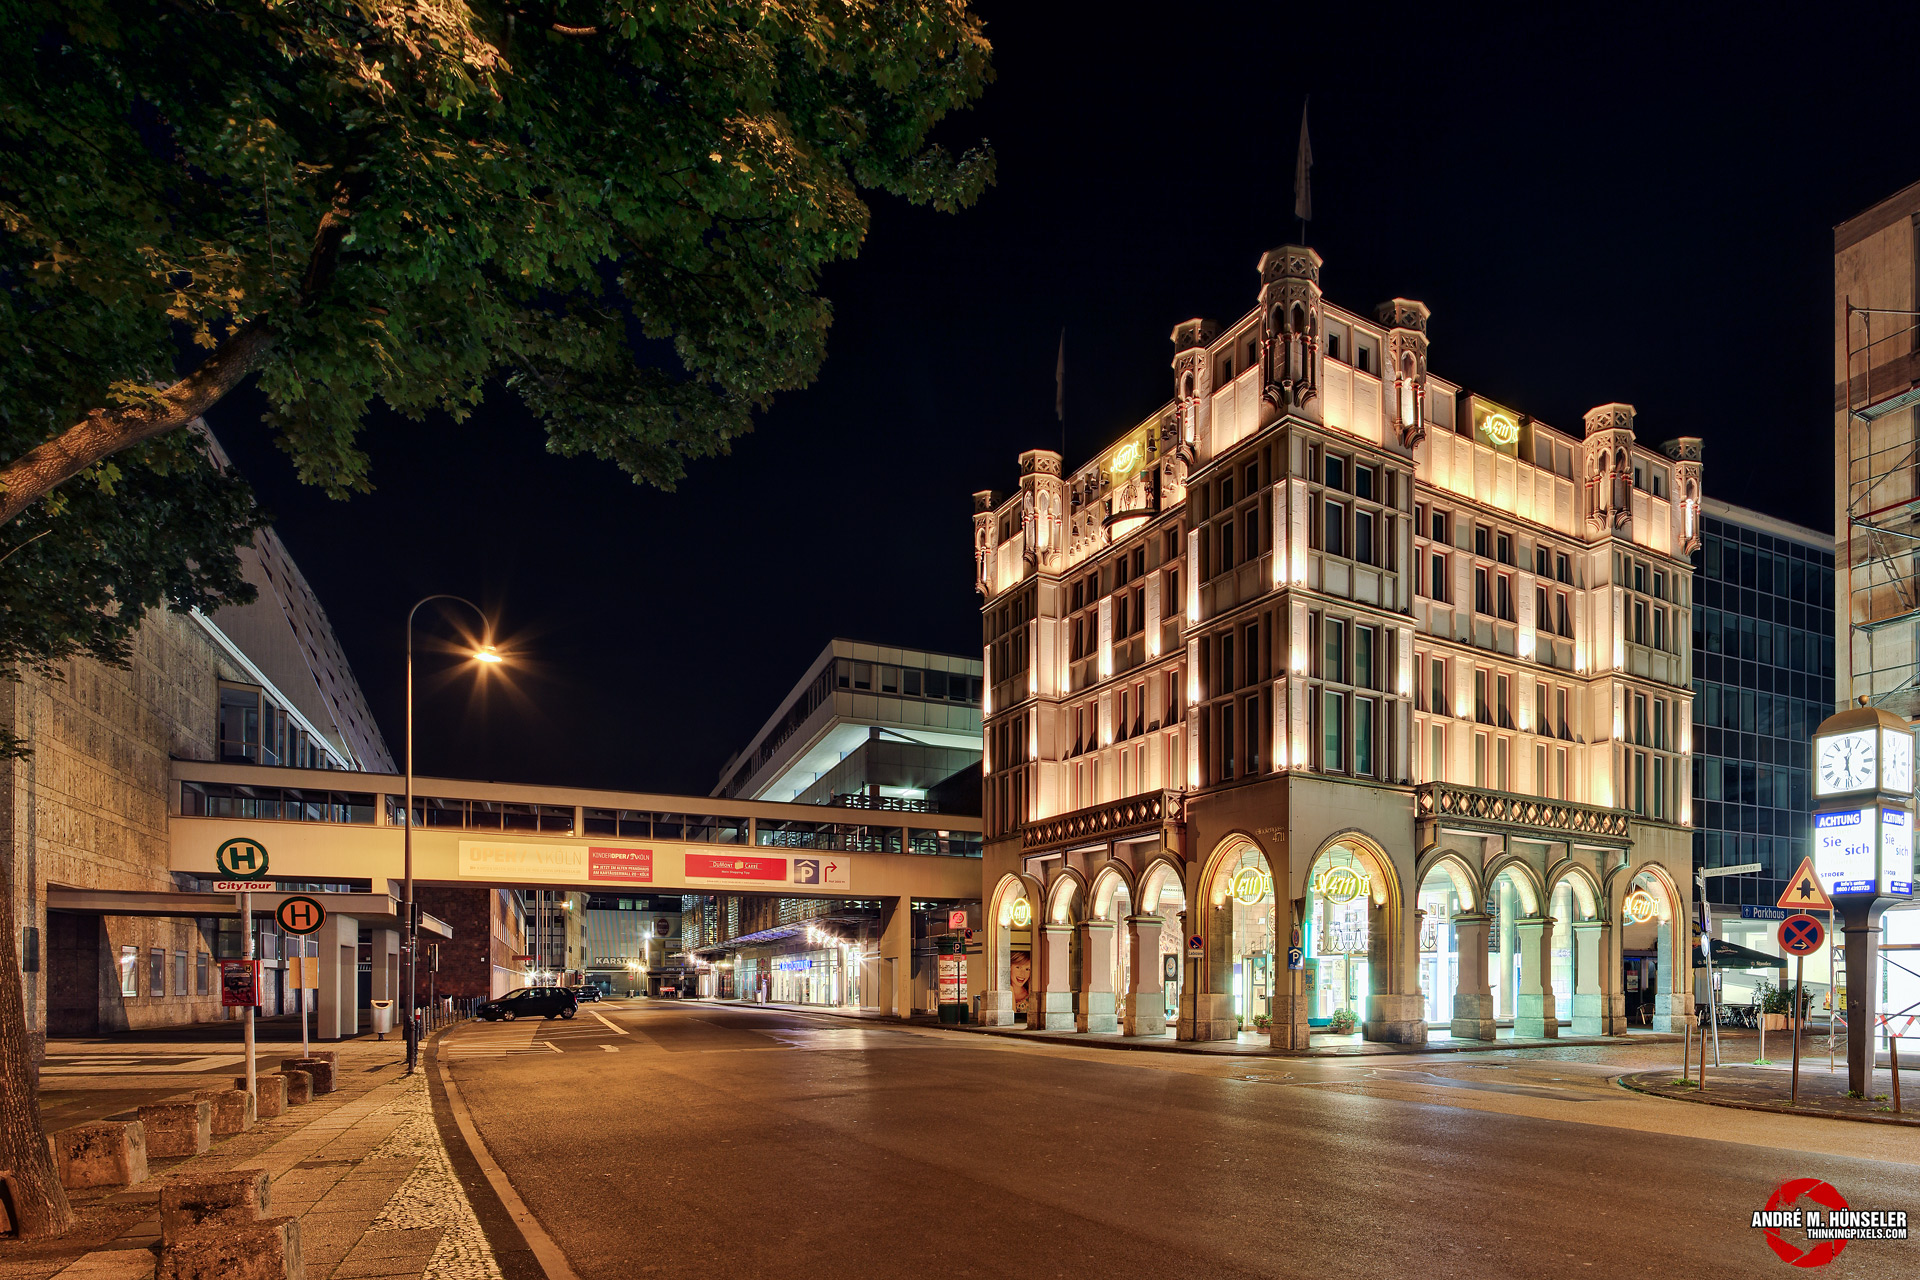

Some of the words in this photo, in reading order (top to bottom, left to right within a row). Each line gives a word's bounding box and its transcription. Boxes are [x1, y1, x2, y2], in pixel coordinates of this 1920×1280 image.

[1492, 420, 1510, 439] 4711
[1819, 813, 1860, 828] ACHTUNG
[1884, 812, 1904, 825] ACHTUNG
[1272, 831, 1285, 842] 4711
[1823, 836, 1842, 847] Sie
[1885, 833, 1895, 846] Sie
[1845, 843, 1870, 856] sich
[1895, 845, 1909, 856] sich
[229, 846, 256, 870] H
[801, 866, 814, 883] P
[217, 881, 272, 891] CityTour
[1237, 876, 1259, 896] 4711
[1327, 876, 1356, 895] 4711
[1632, 899, 1651, 915] 4711
[1753, 907, 1785, 919] Parkhaus
[290, 904, 311, 926] H
[1292, 952, 1300, 963] P
